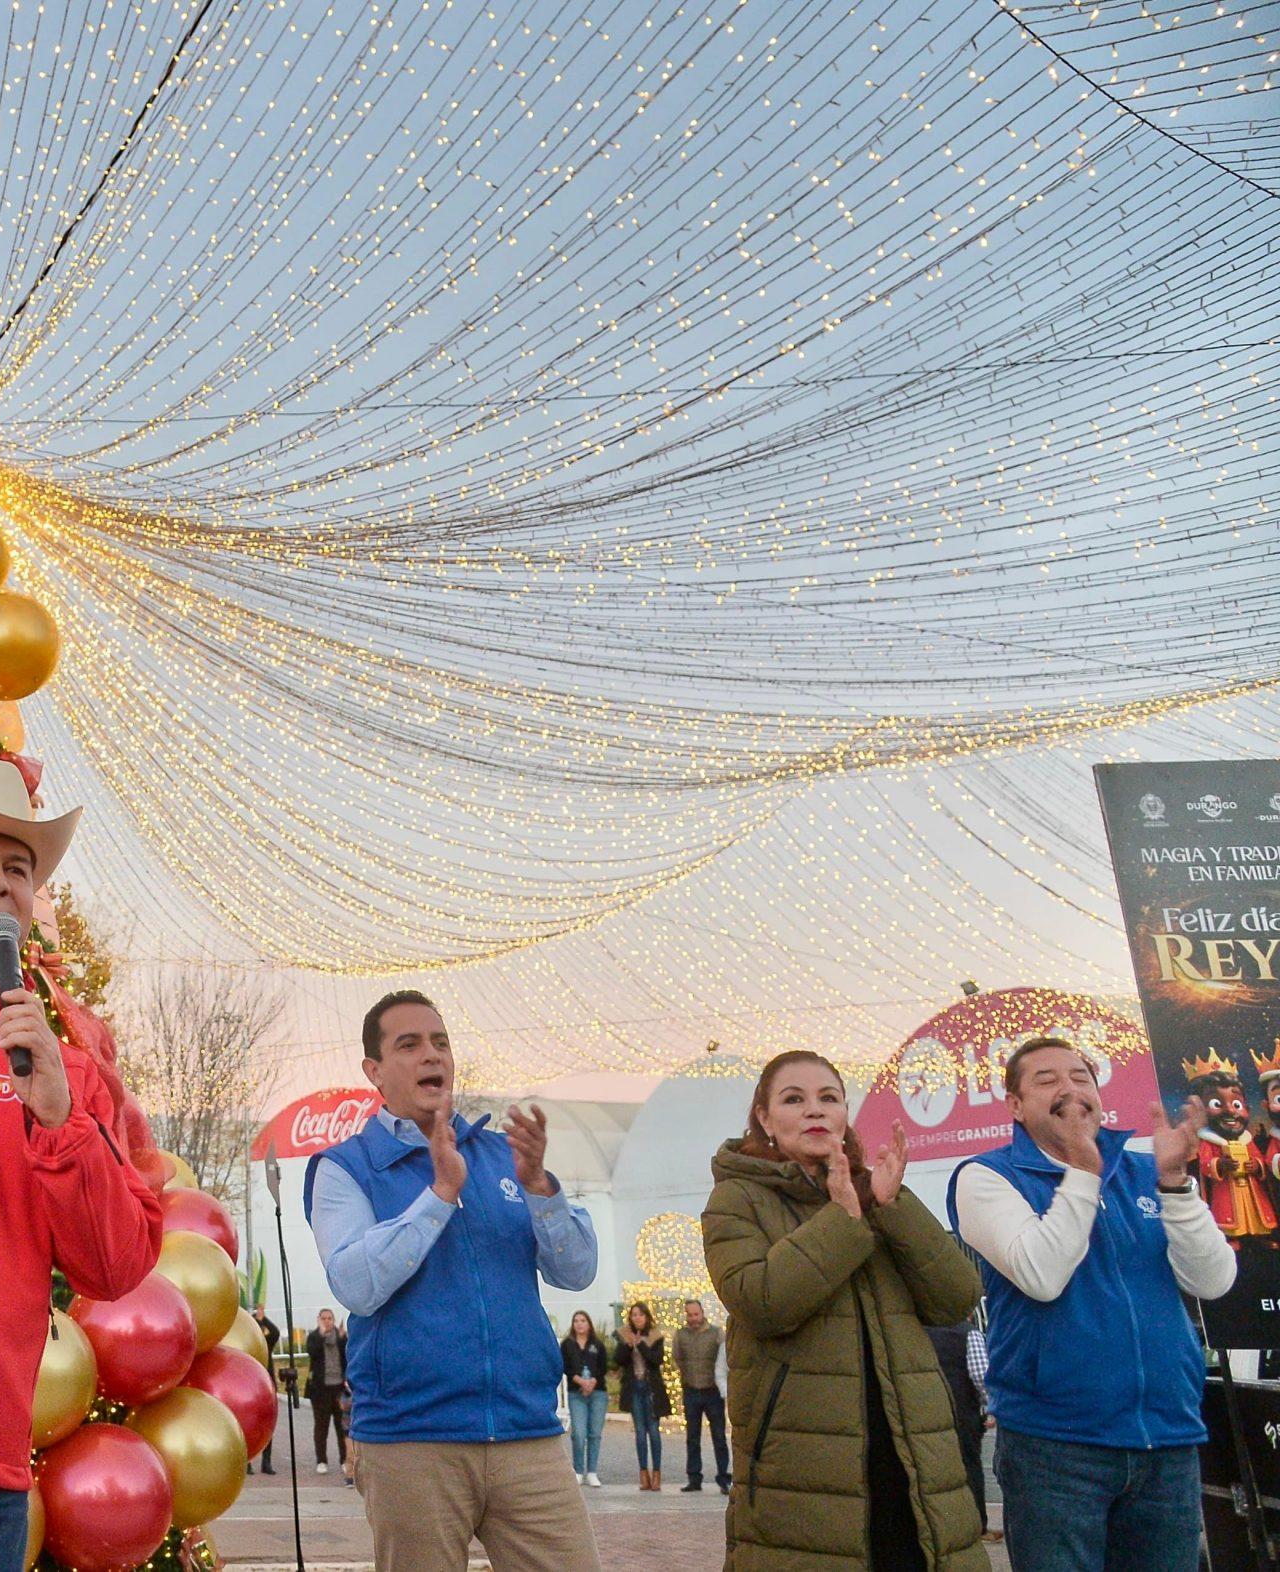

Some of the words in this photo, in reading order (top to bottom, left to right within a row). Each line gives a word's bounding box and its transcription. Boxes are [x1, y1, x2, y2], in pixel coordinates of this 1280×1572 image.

[1186, 801, 1238, 811] DURANGO
[1140, 847, 1206, 863] MAGIA
[1209, 846, 1223, 862] Y
[1187, 865, 1213, 881] EN
[1162, 907, 1235, 933] Feliz
